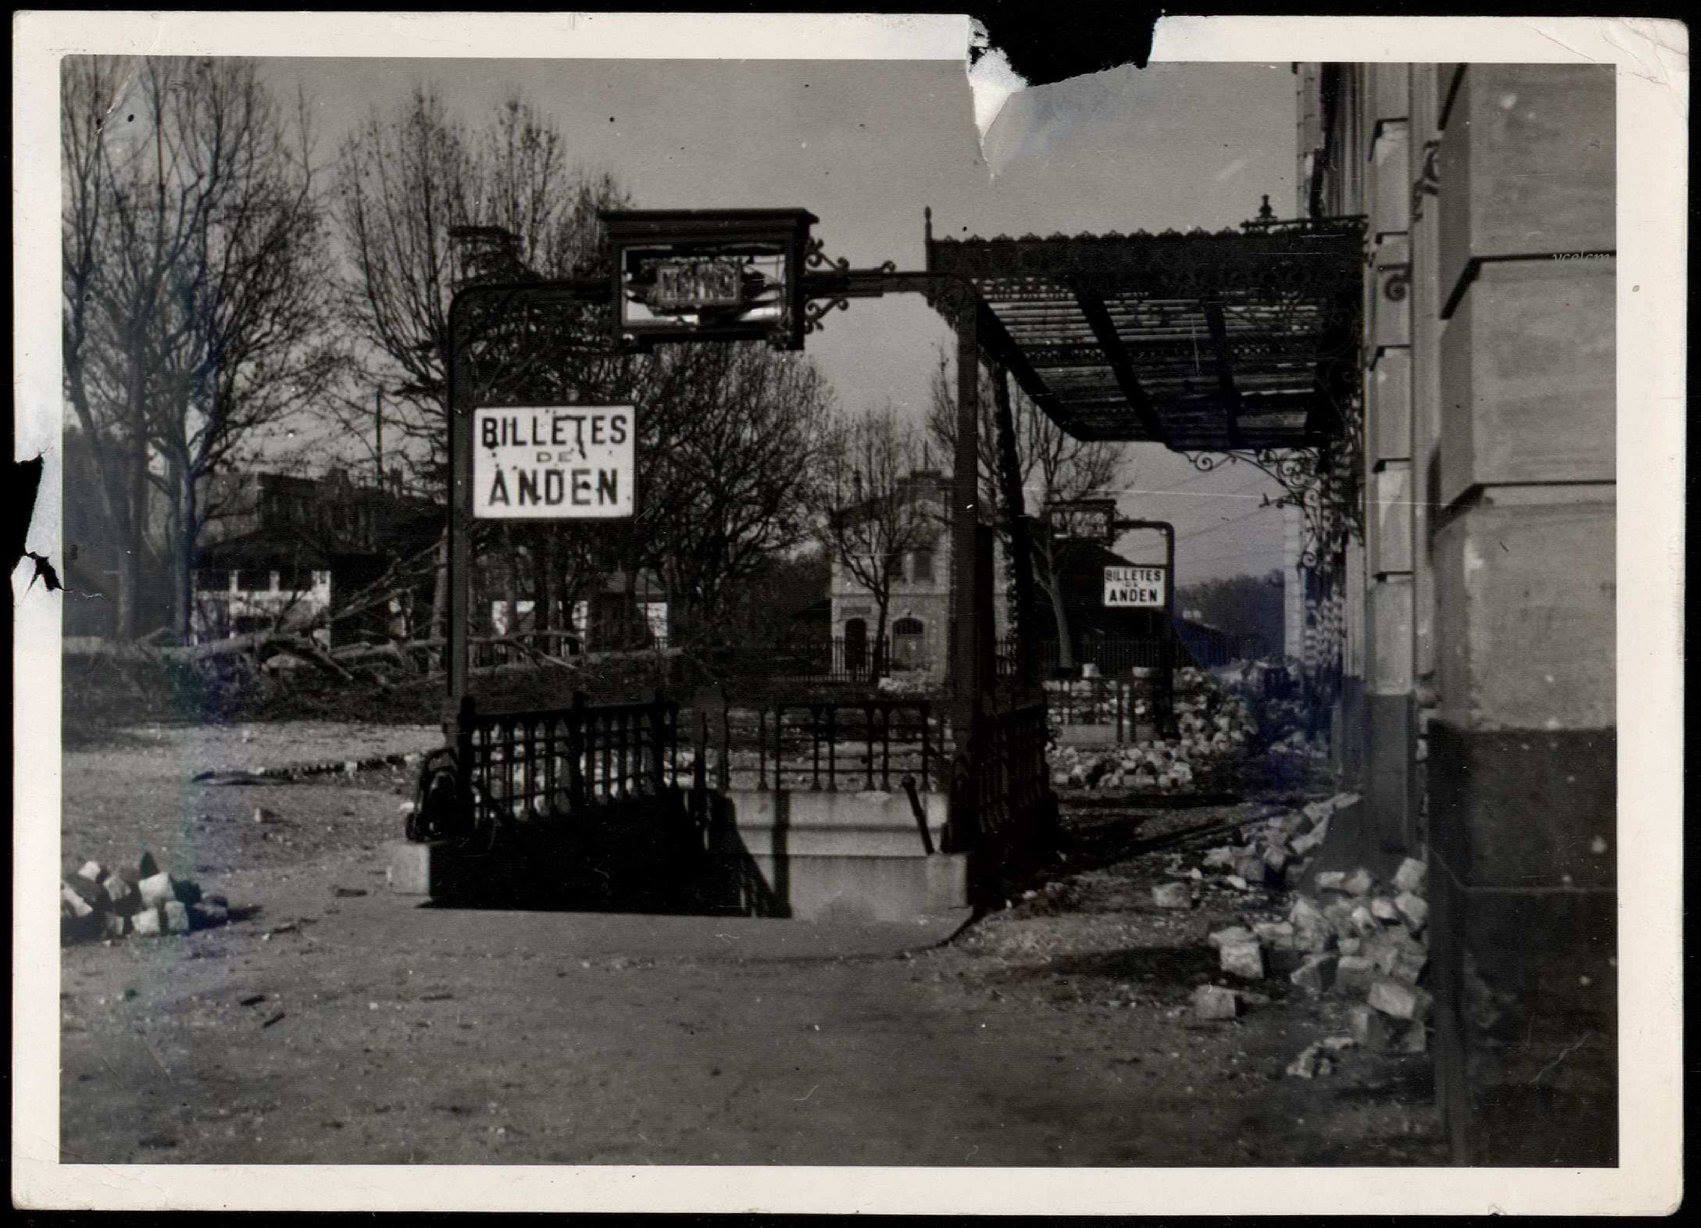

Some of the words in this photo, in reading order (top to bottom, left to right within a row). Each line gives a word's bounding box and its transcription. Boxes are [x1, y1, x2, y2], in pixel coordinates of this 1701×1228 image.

[481, 414, 628, 448] BILLETES
[536, 451, 573, 463] DE
[488, 467, 618, 506] ANDEN
[1105, 569, 1161, 581] BILLETES
[1109, 589, 1158, 602] ANDEN
